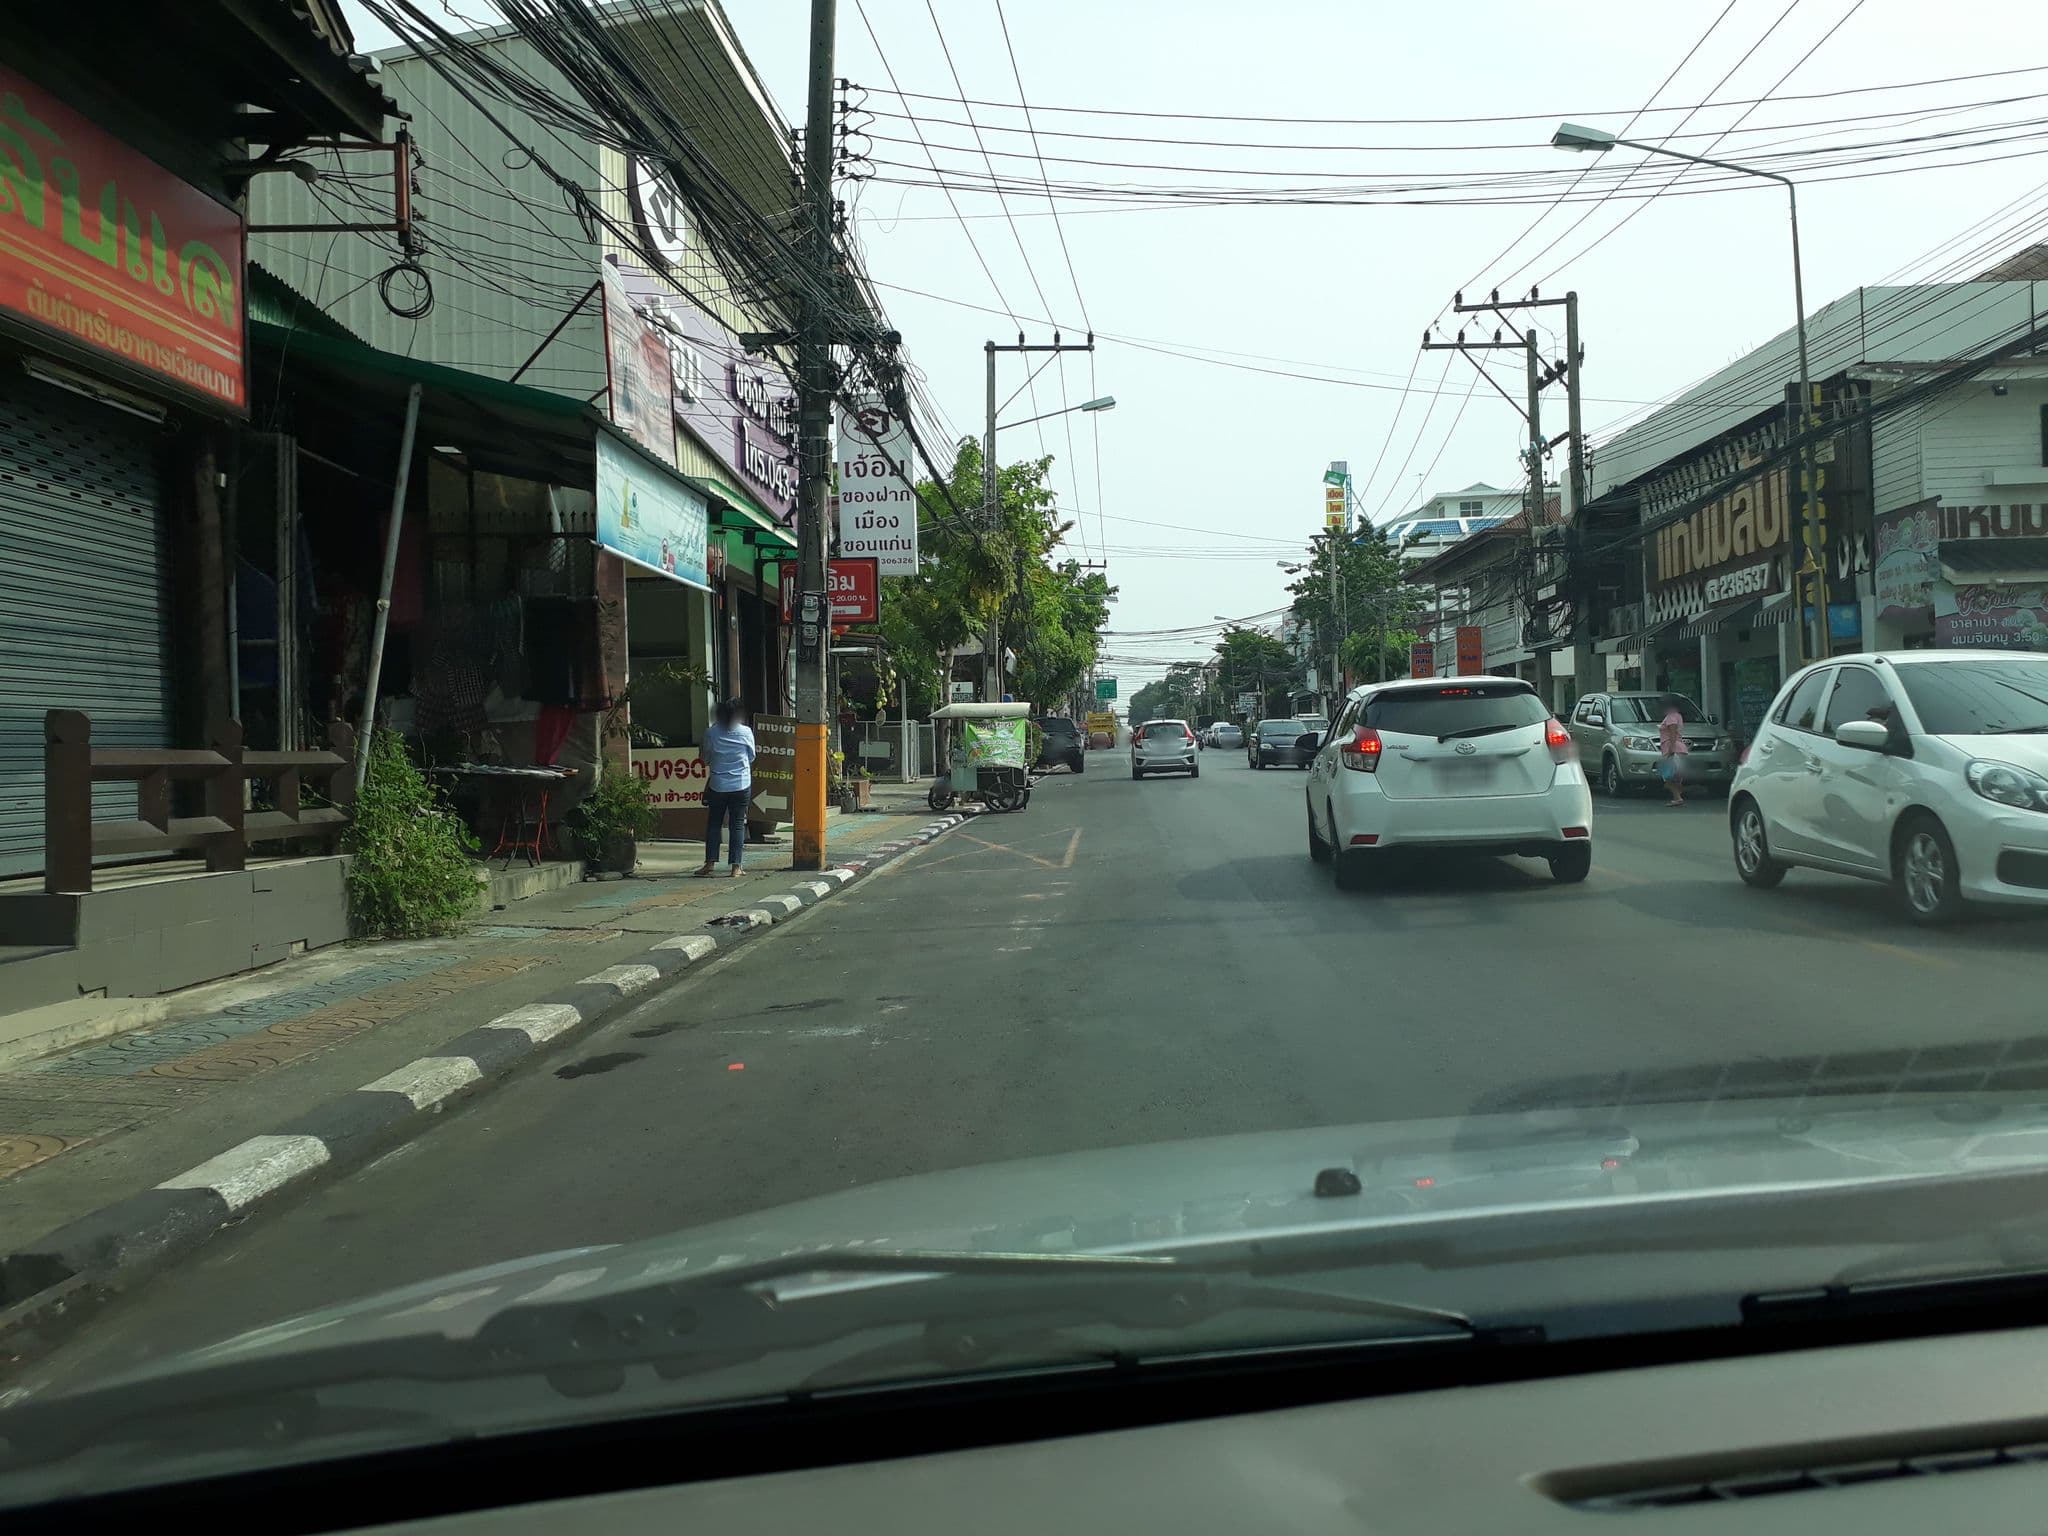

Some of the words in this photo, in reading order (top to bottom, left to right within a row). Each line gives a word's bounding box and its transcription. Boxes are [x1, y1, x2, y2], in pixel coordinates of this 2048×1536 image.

[842, 485, 911, 503] ของฝาก
[855, 510, 899, 529] เมือง
[843, 534, 912, 551] ขอนแก่น
[1720, 562, 1769, 600] 236537
